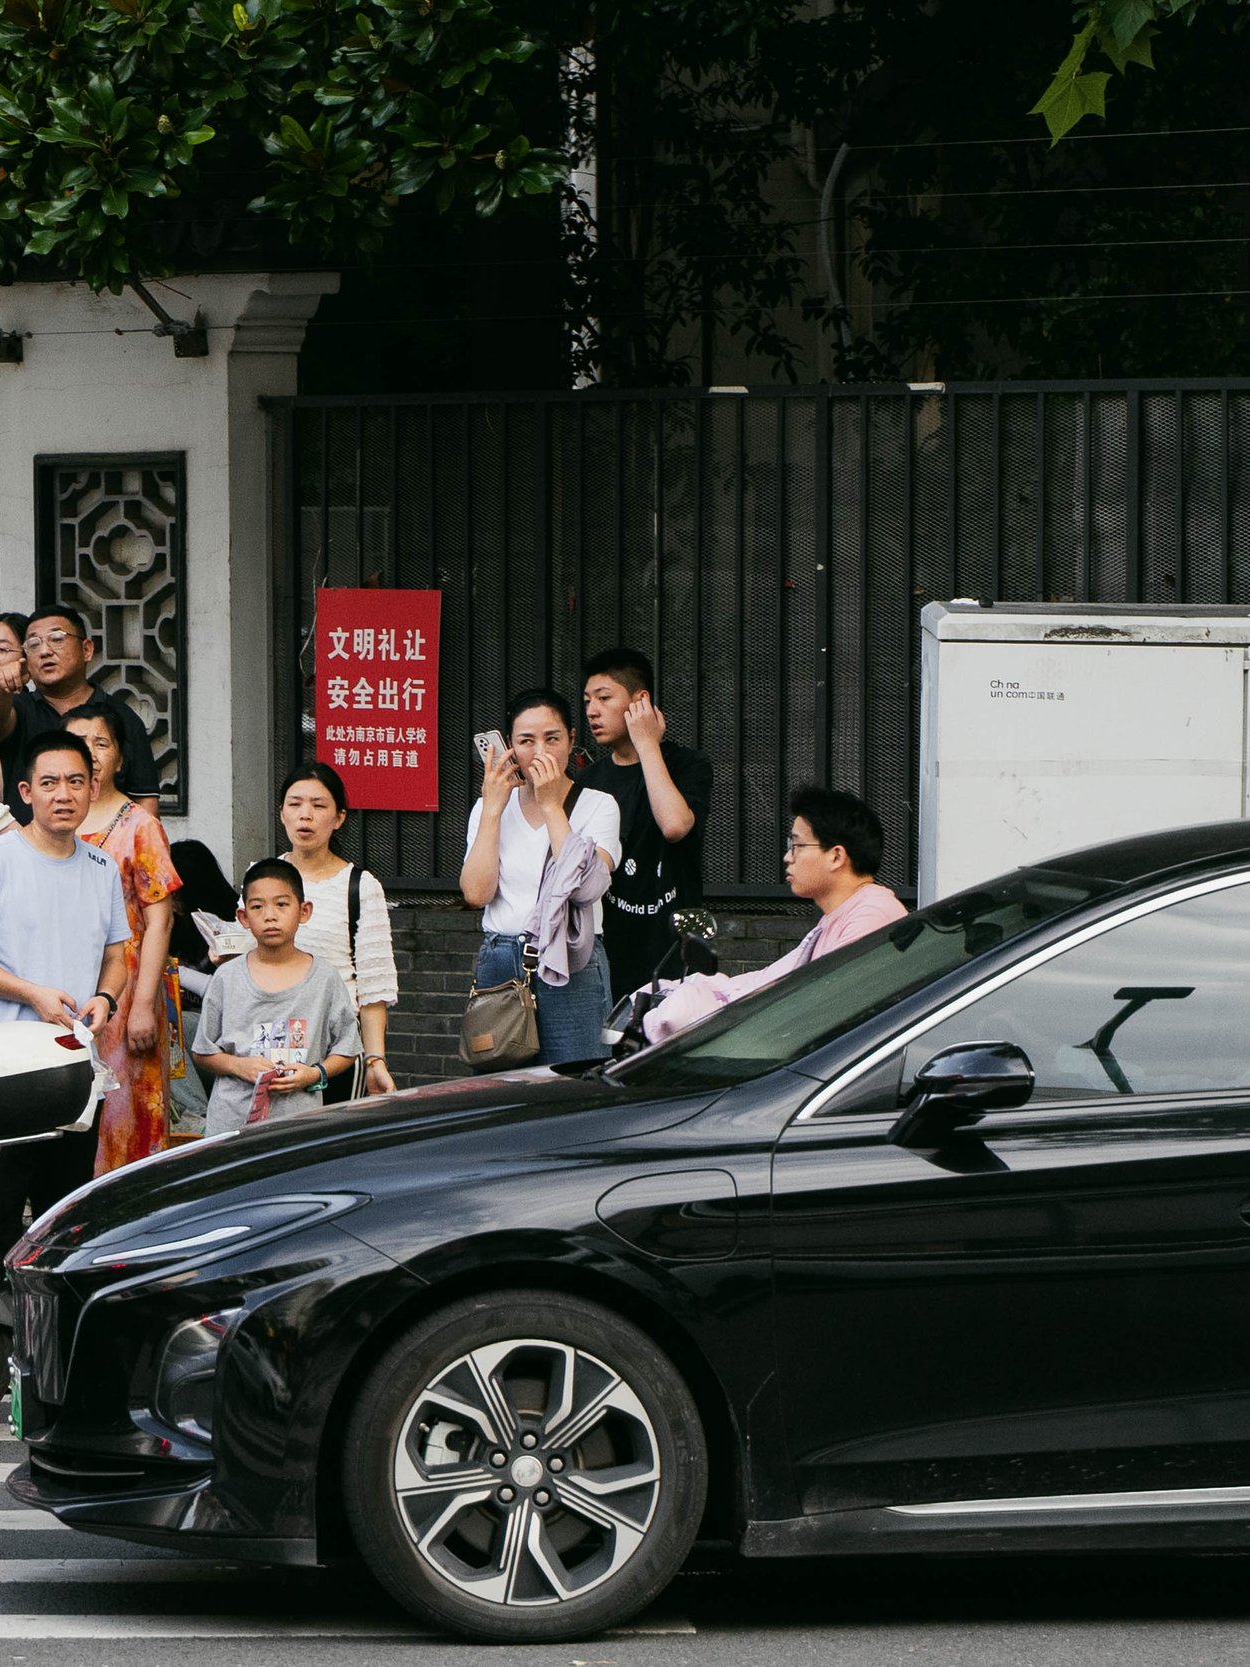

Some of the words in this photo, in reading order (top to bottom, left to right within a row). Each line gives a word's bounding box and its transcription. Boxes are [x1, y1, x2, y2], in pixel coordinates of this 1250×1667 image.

[327, 627, 427, 662] 文明礼让
[327, 676, 427, 711] 安全出行
[990, 680, 1020, 690] Chna
[325, 725, 427, 744] 此处为南京市盲人学校
[334, 748, 419, 768] 请勿占用盲道
[617, 897, 645, 915] World
